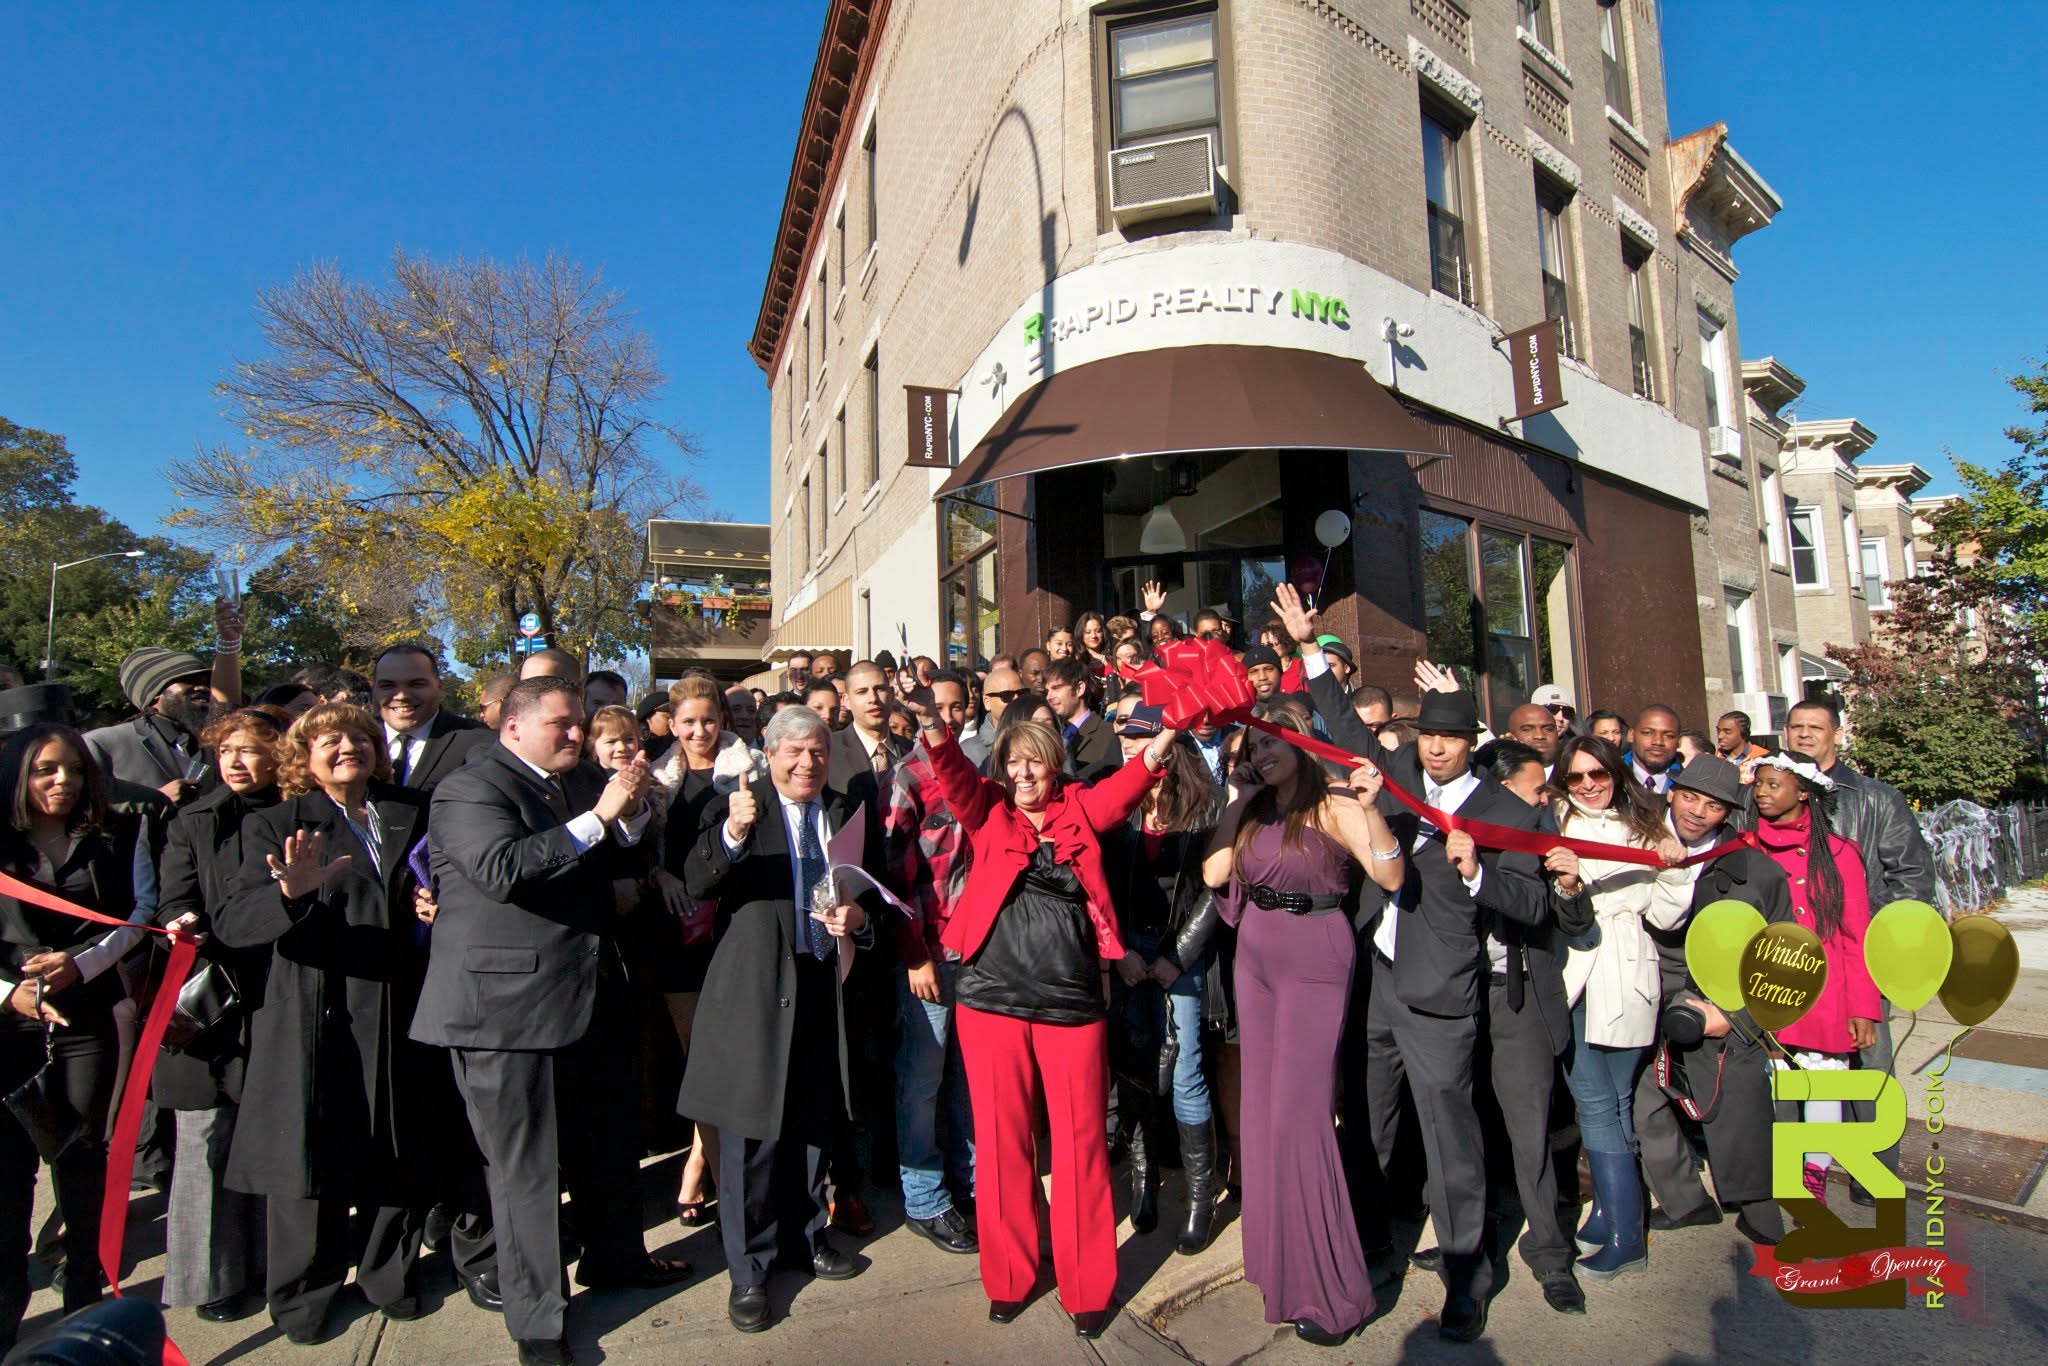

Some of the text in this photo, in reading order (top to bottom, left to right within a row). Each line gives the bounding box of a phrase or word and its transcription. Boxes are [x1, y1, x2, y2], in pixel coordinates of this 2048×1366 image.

[1050, 284, 1350, 344] RAPID REALTY NYC
